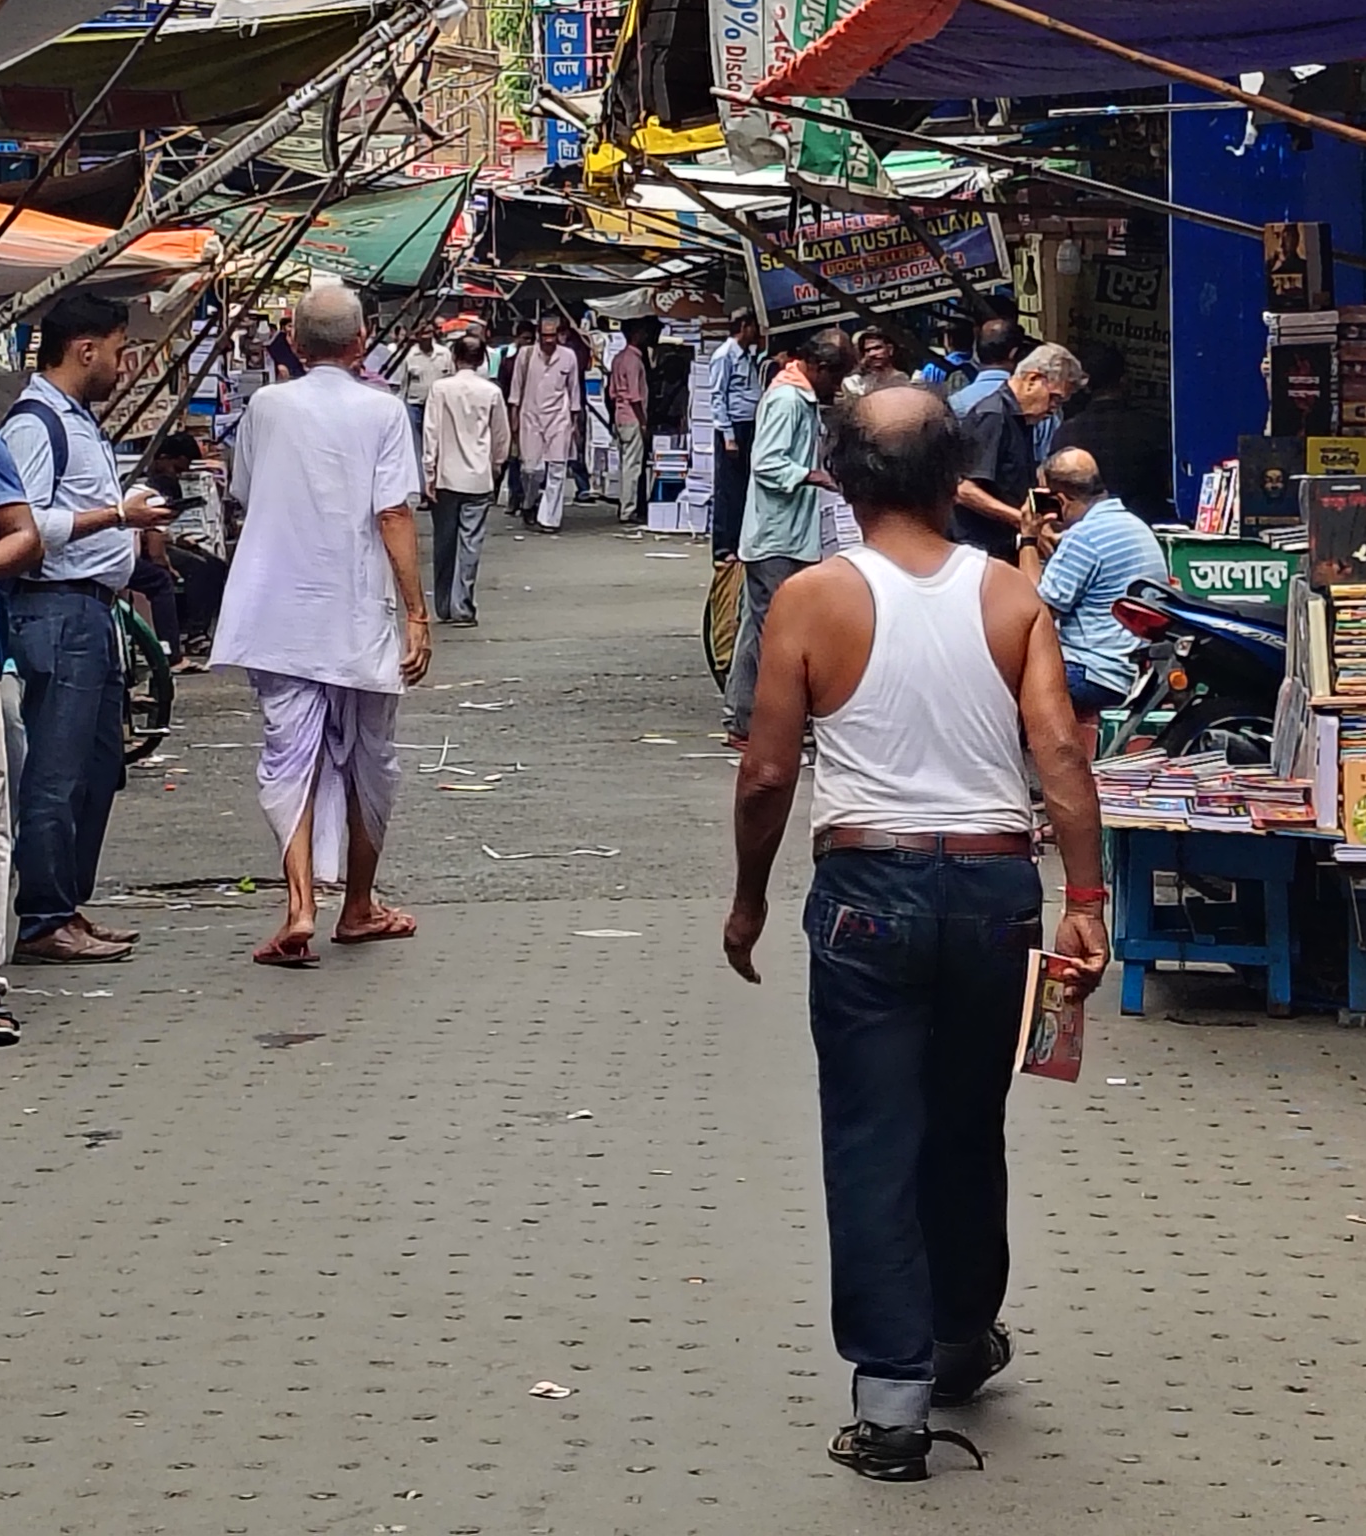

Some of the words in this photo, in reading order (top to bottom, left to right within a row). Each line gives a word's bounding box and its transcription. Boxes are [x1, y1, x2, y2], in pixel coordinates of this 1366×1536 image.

[723, 44, 748, 119] Discont
[850, 210, 984, 254] PUSTAALAYA
[1188, 560, 1288, 590] অশোক
